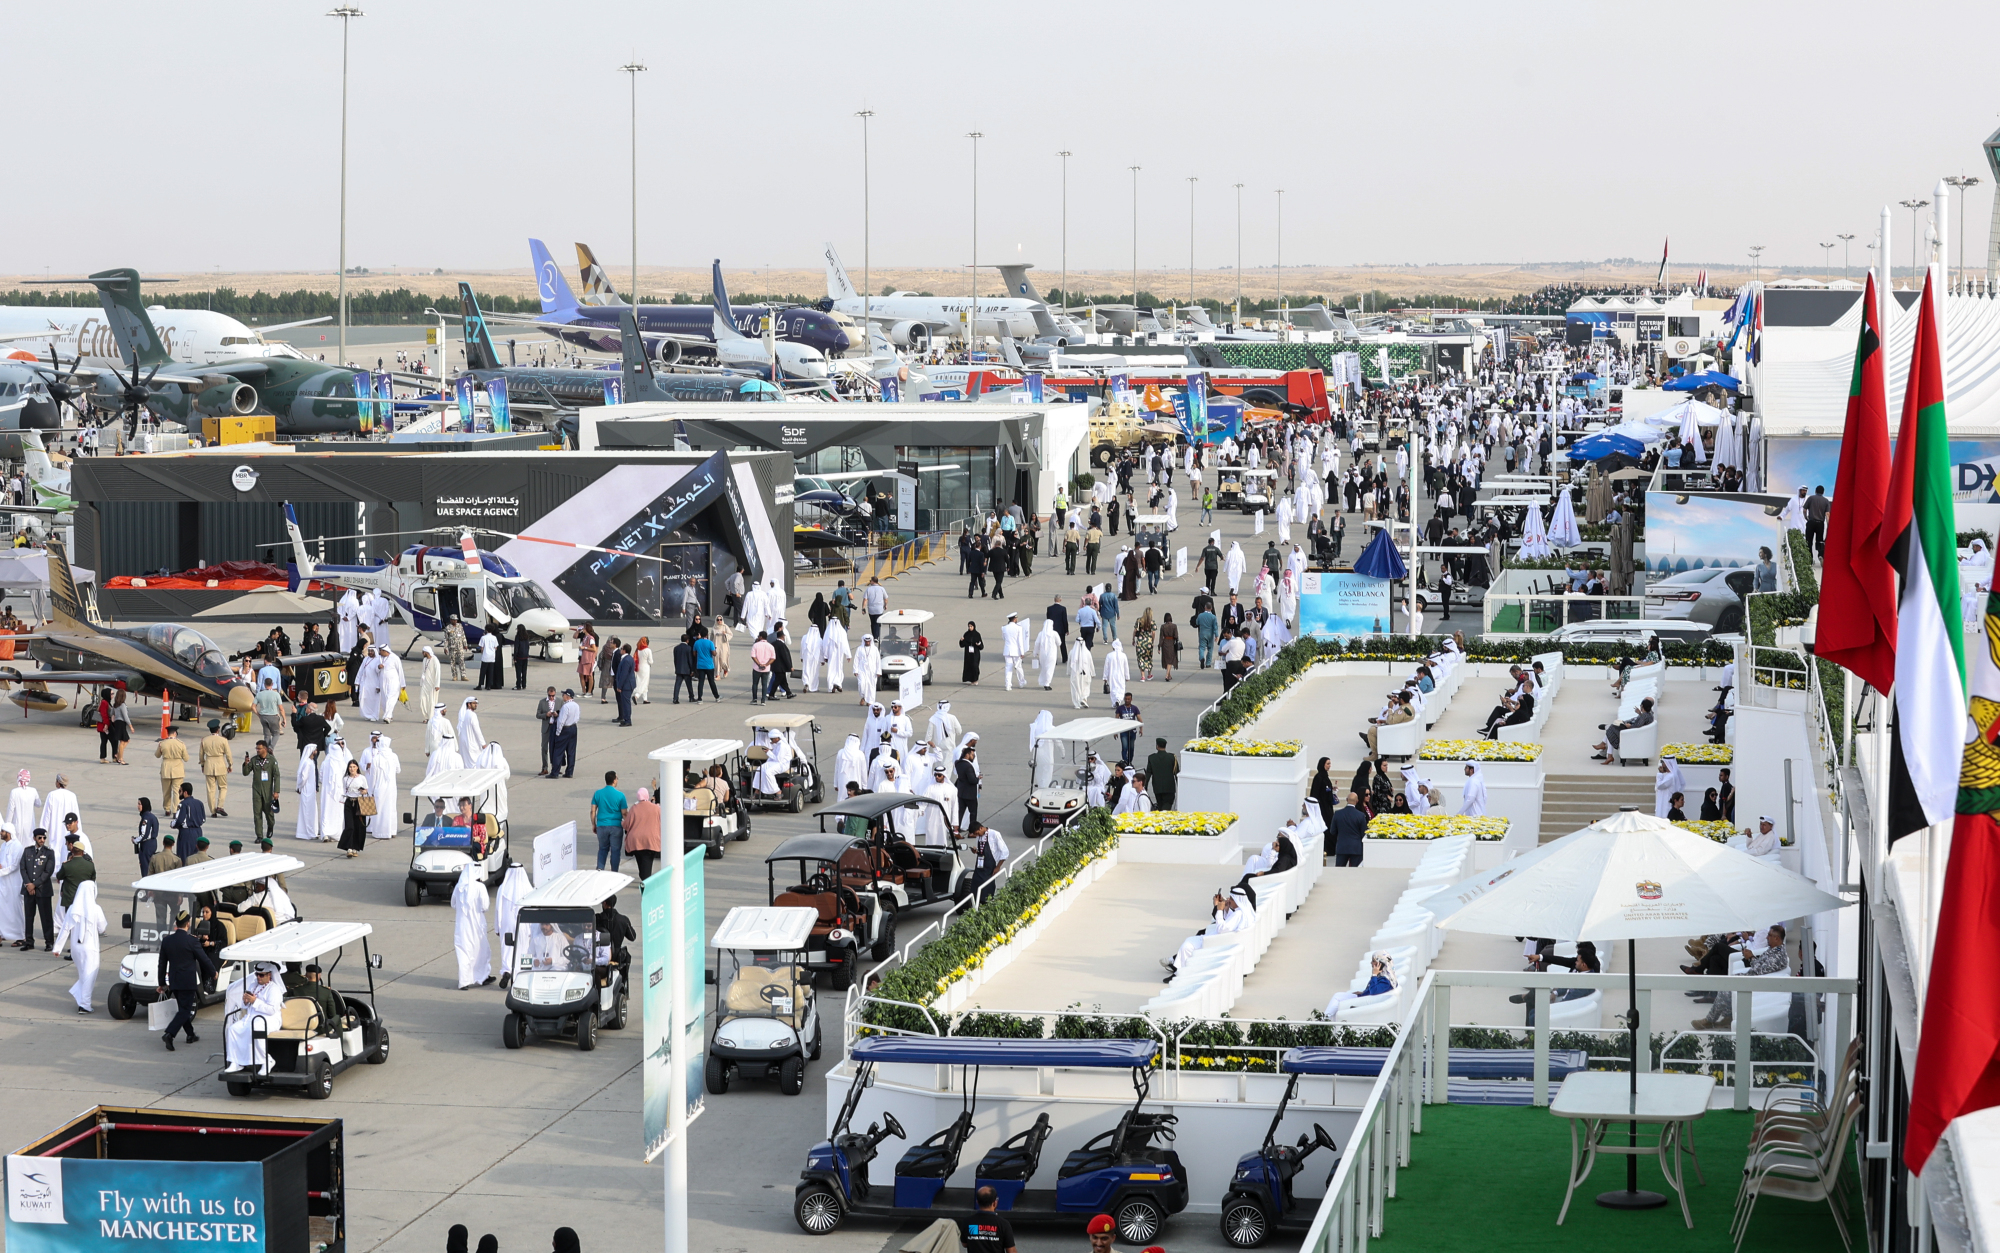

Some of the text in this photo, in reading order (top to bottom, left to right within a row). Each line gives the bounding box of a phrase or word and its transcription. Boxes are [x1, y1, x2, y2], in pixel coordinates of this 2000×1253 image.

[465, 316, 481, 343] E2
[783, 427, 806, 436] SDF
[465, 496, 496, 506] الإمارات
[436, 508, 519, 516] UAE SPACE AGENCY
[590, 514, 666, 576] PLANET X
[1338, 580, 1349, 589] Fly
[1352, 580, 1366, 588] with
[20, 1200, 52, 1209] KUWAIT
[98, 1190, 256, 1219] Fly with us to
[99, 1219, 258, 1242] MANCHESTER
